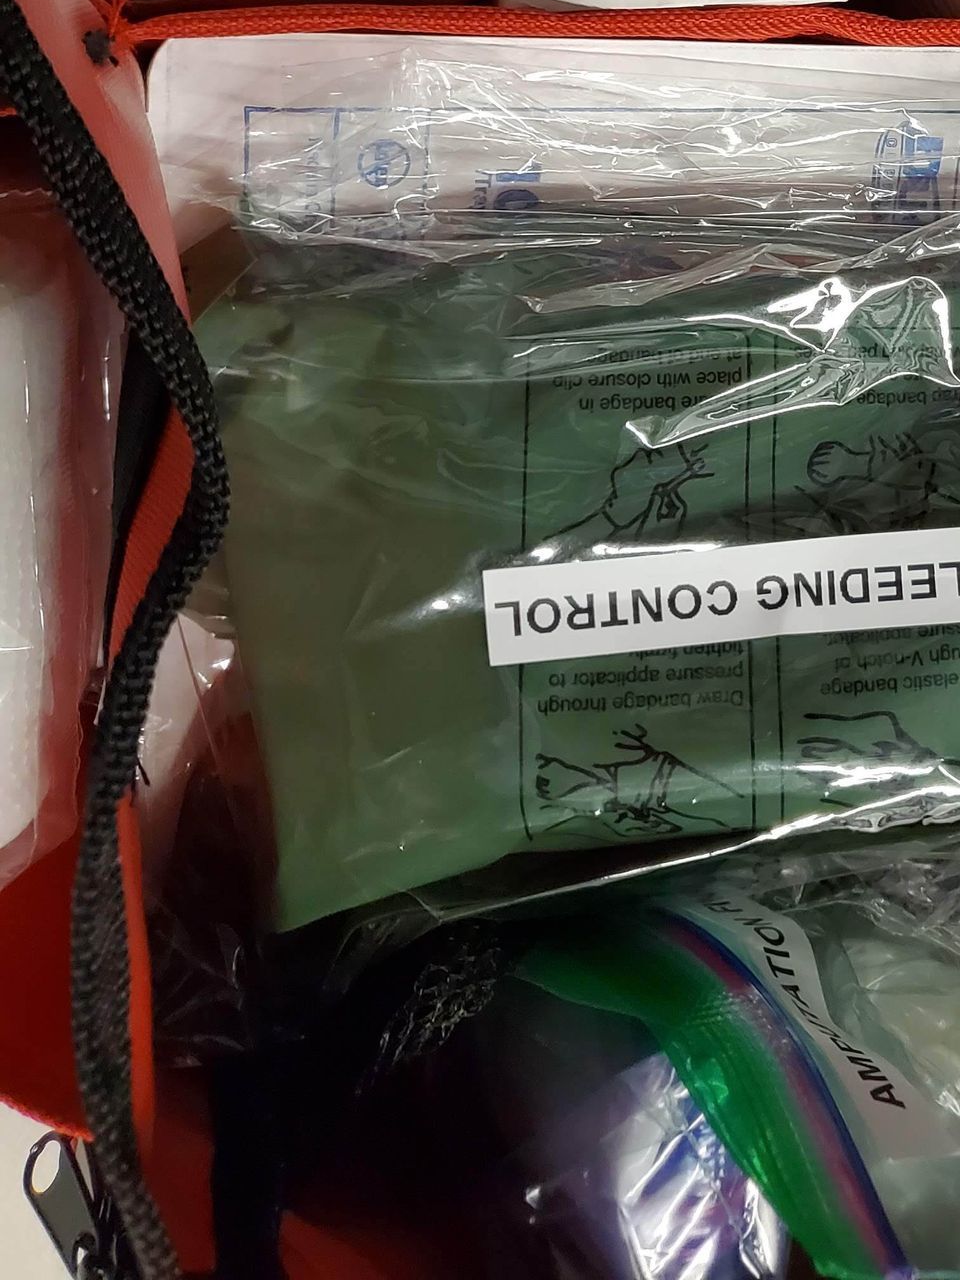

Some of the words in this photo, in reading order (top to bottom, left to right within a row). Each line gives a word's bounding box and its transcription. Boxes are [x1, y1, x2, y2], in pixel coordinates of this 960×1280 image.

[552, 375, 583, 392] clip
[587, 372, 652, 390] closure
[656, 372, 692, 389] with
[696, 367, 743, 387] place
[578, 398, 594, 413] in
[599, 393, 677, 412] bandage
[856, 390, 928, 408] bandage
[494, 579, 738, 637] CONTROL
[834, 657, 852, 673] of
[856, 649, 925, 671] V-notch
[548, 673, 566, 689] to
[570, 664, 661, 689] applicator
[665, 660, 744, 684] pressure
[902, 671, 960, 693] elastic
[819, 677, 899, 698] bandage
[536, 694, 607, 717] through
[611, 691, 692, 712] bandage
[699, 689, 744, 707] Draw
[733, 917, 907, 1110] AMPUTATION
